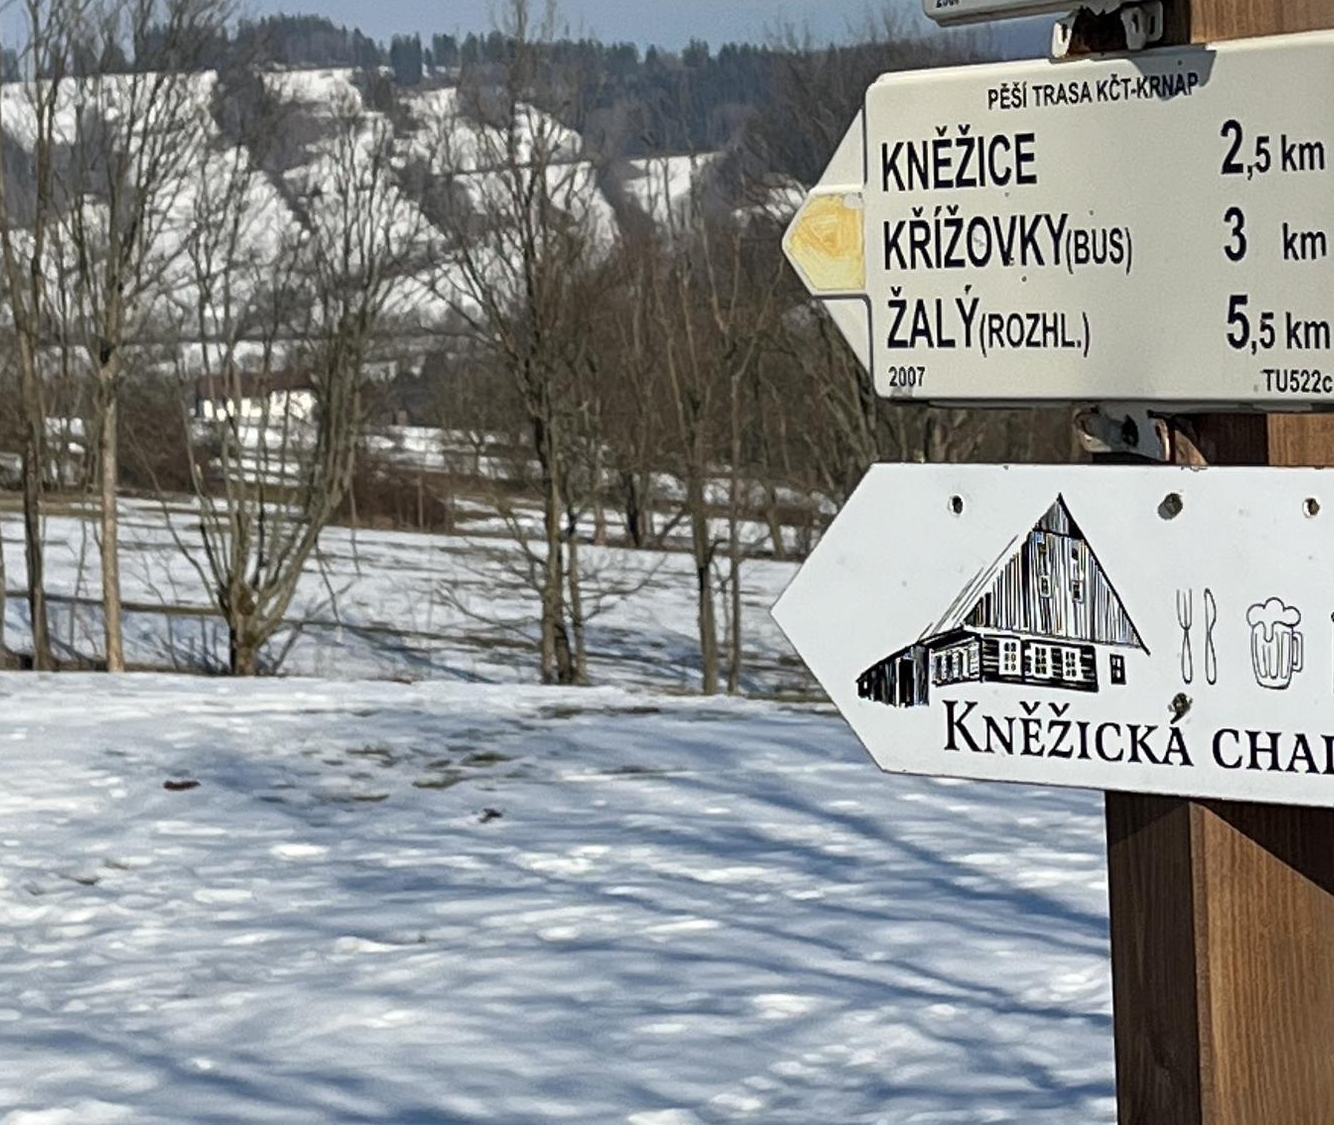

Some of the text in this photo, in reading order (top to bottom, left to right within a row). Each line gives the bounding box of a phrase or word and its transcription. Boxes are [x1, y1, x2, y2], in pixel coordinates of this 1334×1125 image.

[988, 72, 1199, 110] PĚŠÍ TRASA KČT-KRNAP
[882, 119, 1325, 192] KNĚŽICE 2,5 km
[1223, 207, 1247, 261] 3
[1283, 222, 1327, 260] km
[1226, 294, 1275, 355] 5,5
[1286, 311, 1331, 349] km
[889, 366, 1333, 393] 2007 TU522c
